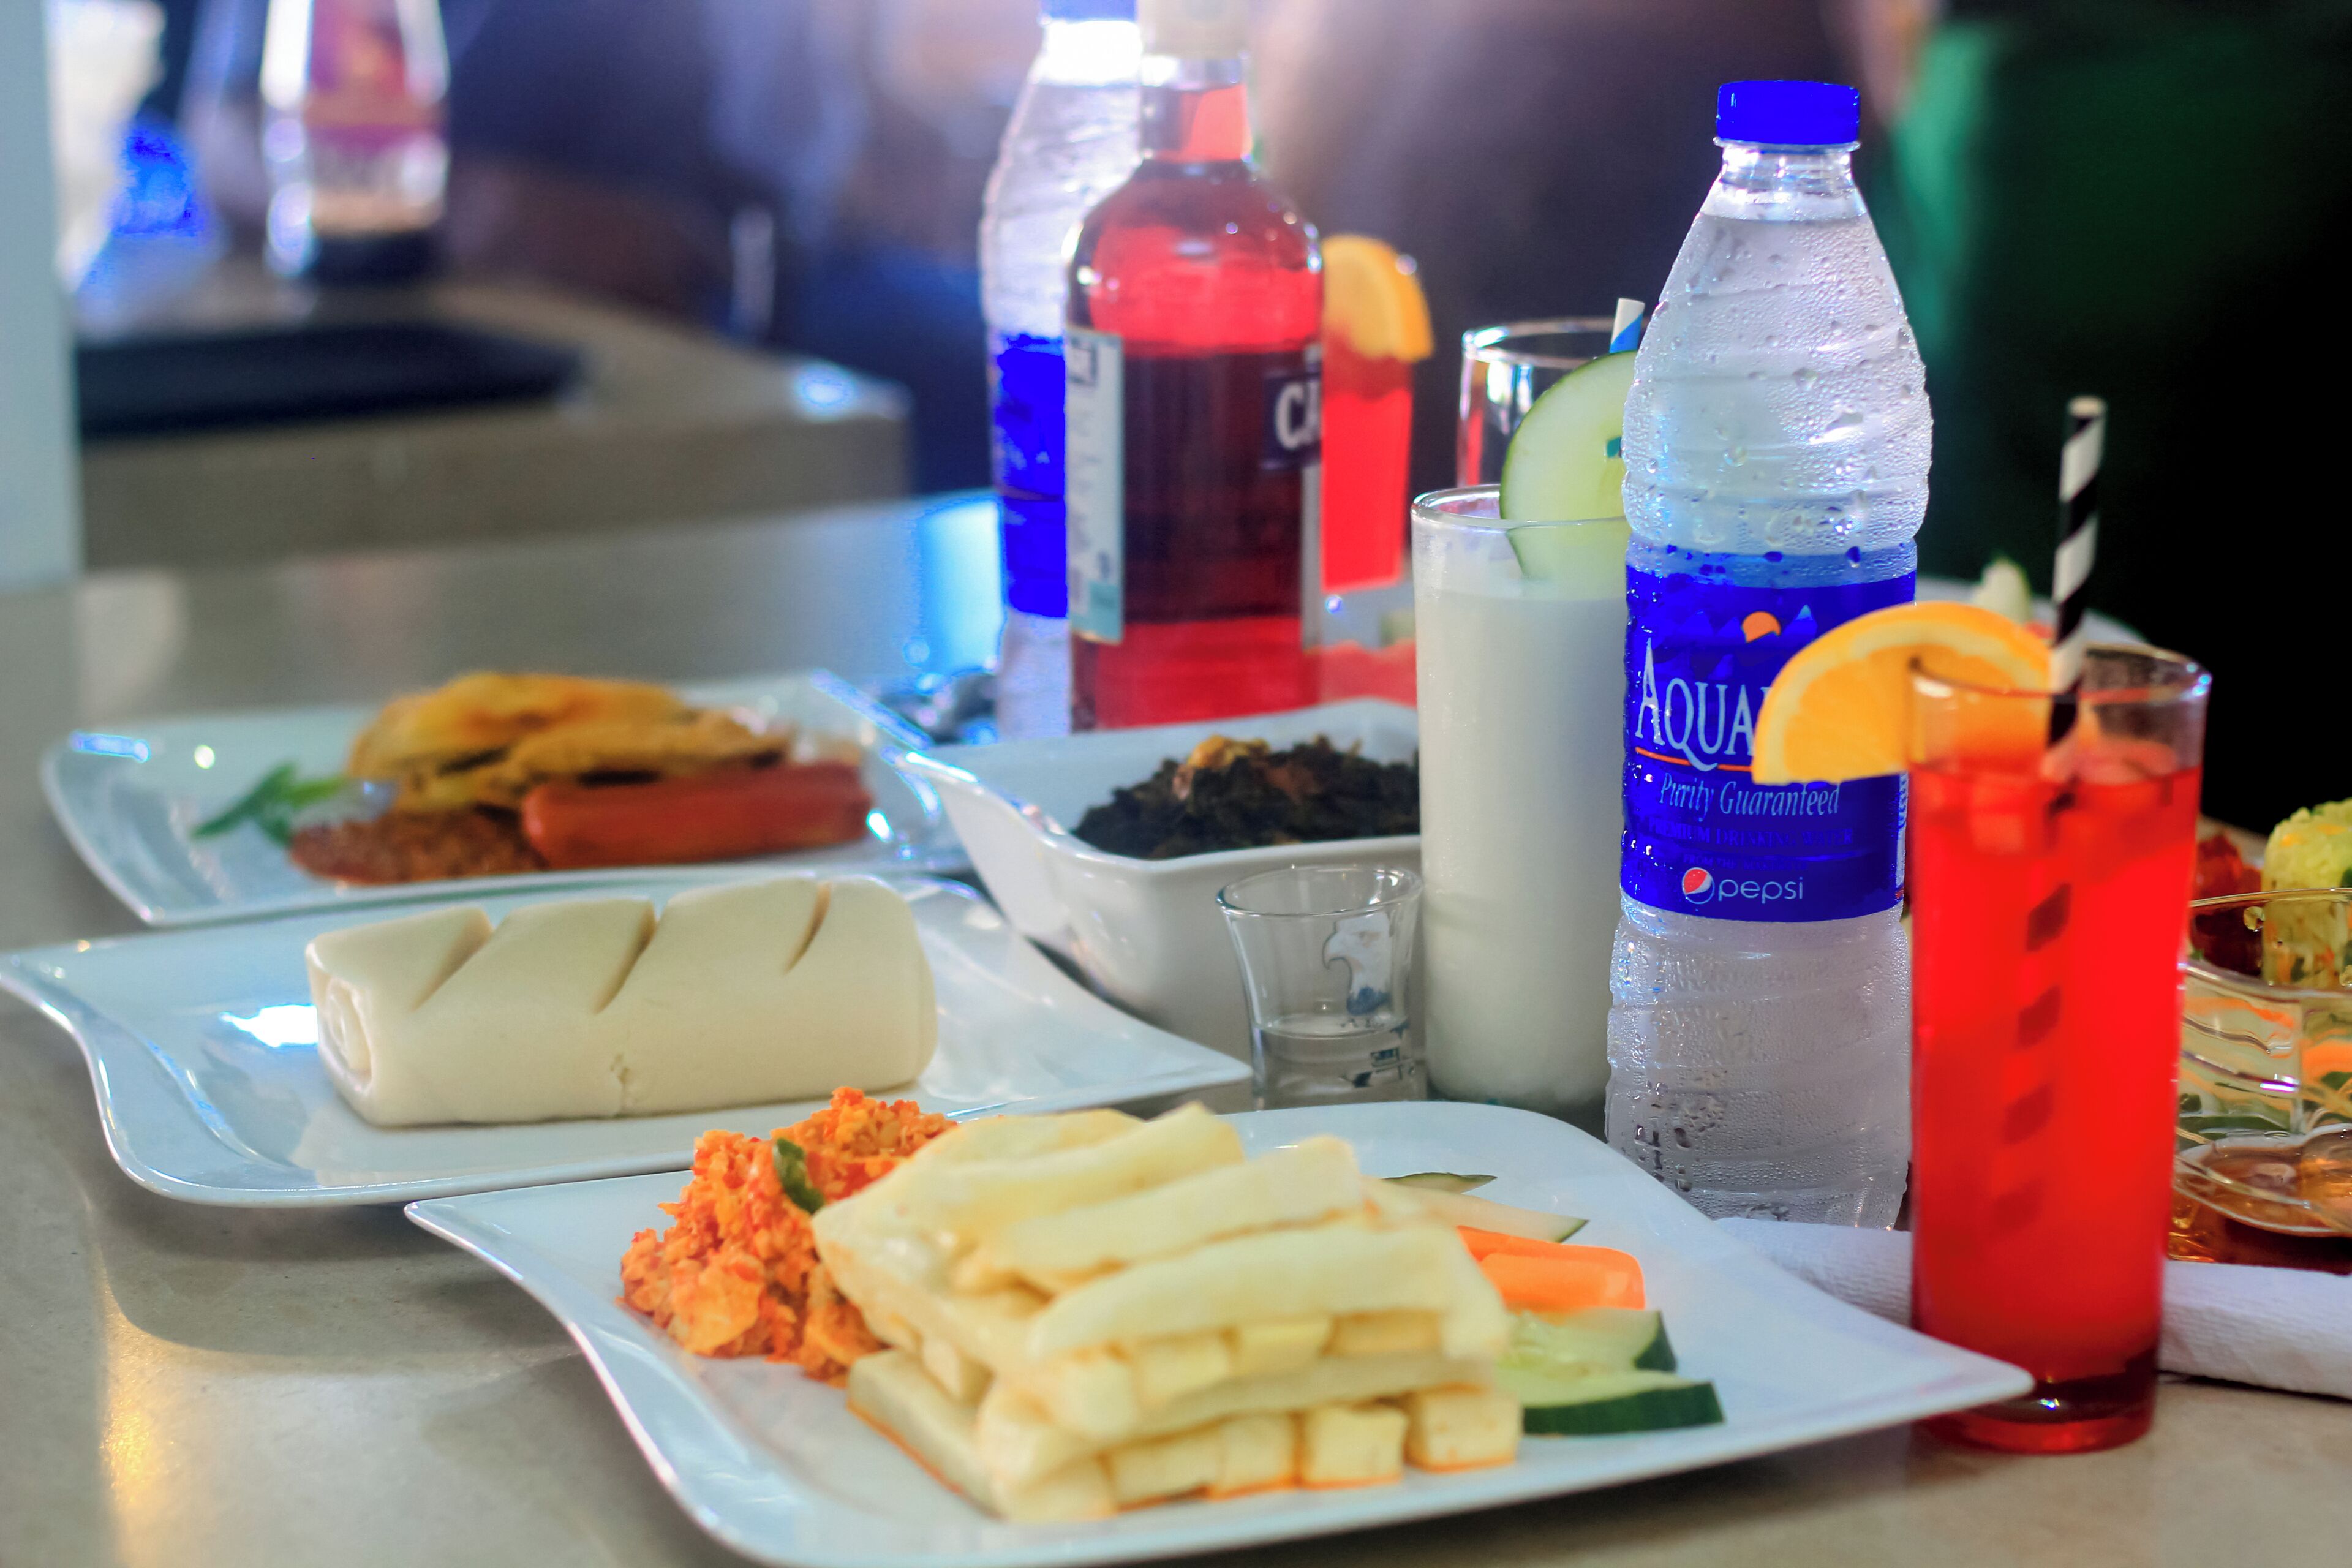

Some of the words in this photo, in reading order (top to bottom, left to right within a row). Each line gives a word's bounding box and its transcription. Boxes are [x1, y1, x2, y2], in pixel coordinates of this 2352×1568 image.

[1635, 637, 1772, 772] AQUA
[1659, 772, 1715, 822] Purity
[1719, 780, 1840, 816] Guaranteed
[1718, 876, 1803, 904] pepsi
